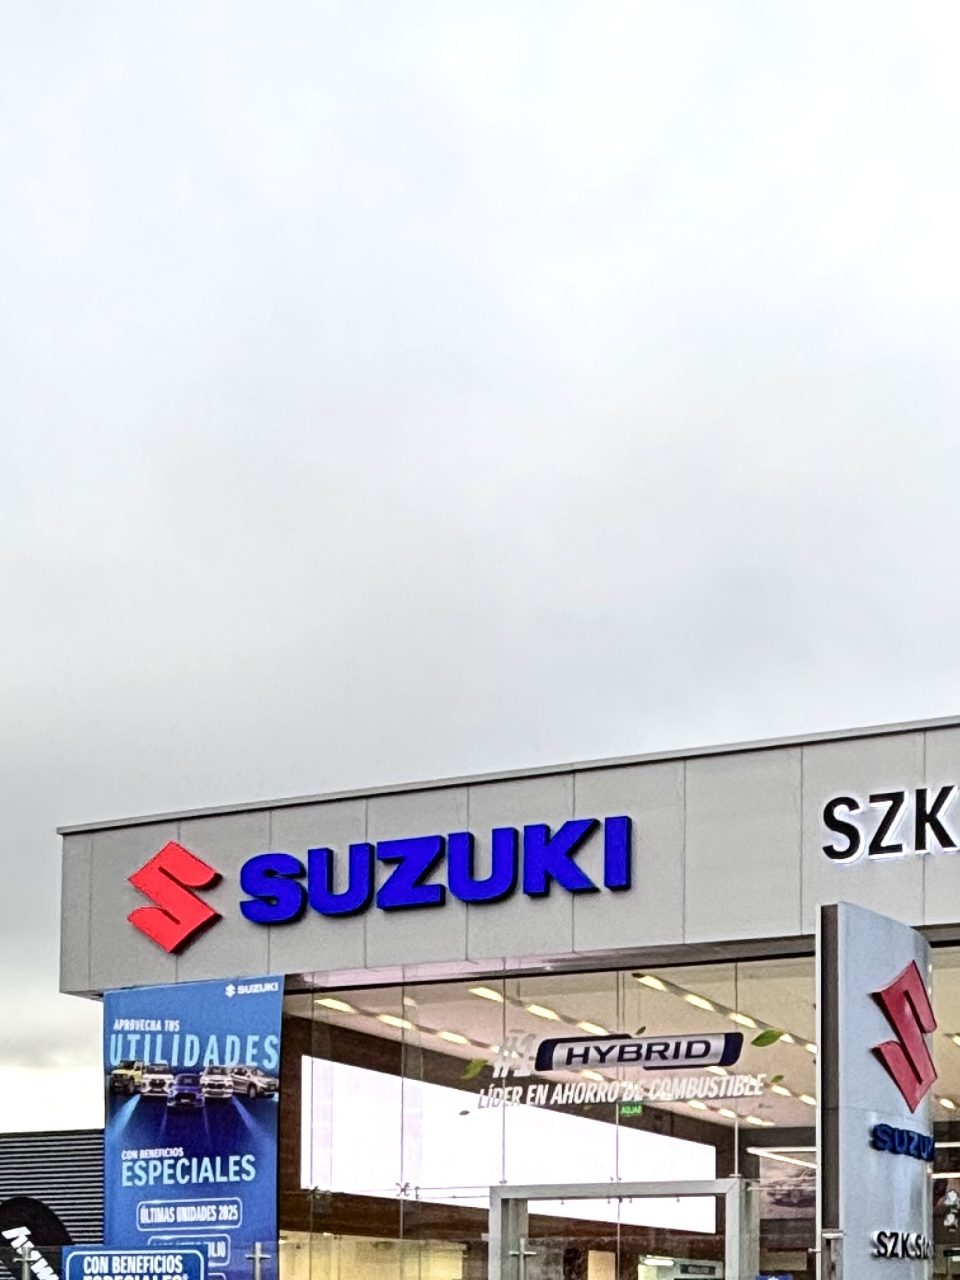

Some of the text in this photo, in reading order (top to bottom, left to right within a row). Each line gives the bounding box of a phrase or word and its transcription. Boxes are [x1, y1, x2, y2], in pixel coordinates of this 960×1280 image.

[822, 785, 957, 860] SZK
[239, 816, 631, 925] SUZUKI
[237, 982, 279, 995] SUZUKI
[113, 1018, 180, 1032] APROVECHA TUS
[109, 1034, 280, 1070] UTILIDADES
[565, 1039, 712, 1066] HYBRID
[478, 1073, 768, 1109] LÍDER EN AHORRO DE COMBUSTIBLE
[121, 1147, 184, 1161] CON BENEFICIOS
[121, 1154, 257, 1187] ESPECIALES
[176, 1204, 217, 1222] UNIDADES
[877, 1230, 910, 1259] SZK
[83, 1254, 183, 1274] CON BENEFICIOS
